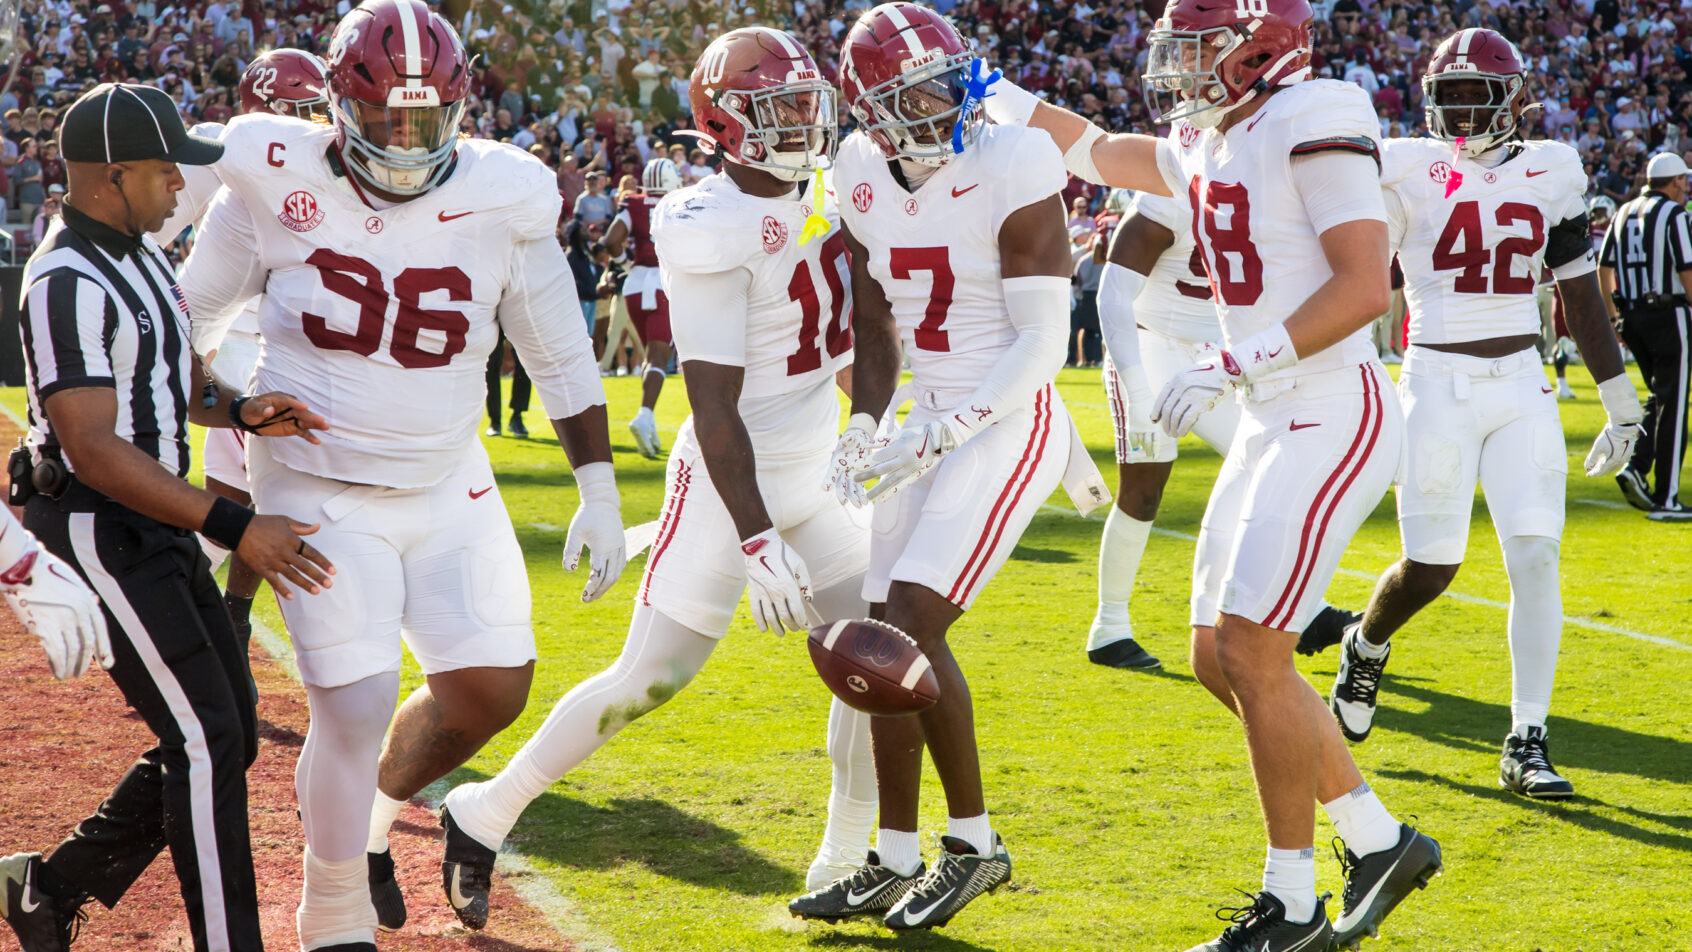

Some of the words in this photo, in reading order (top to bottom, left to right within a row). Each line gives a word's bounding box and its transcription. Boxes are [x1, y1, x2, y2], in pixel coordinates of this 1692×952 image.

[796, 70, 816, 80] BAMA
[912, 55, 934, 68] BAMA
[252, 67, 278, 94] 22
[402, 90, 428, 101] BAMA
[267, 142, 286, 168] C
[1429, 161, 1452, 184] SE
[285, 191, 317, 222] SEC
[852, 182, 873, 213] SEC
[762, 216, 781, 245] SEC
[1188, 173, 1263, 305] 18
[1626, 217, 1647, 263] R
[1432, 200, 1545, 294] 42
[302, 248, 472, 368] 96
[787, 229, 853, 376] 10
[889, 246, 955, 352] 7
[138, 310, 151, 335] S
